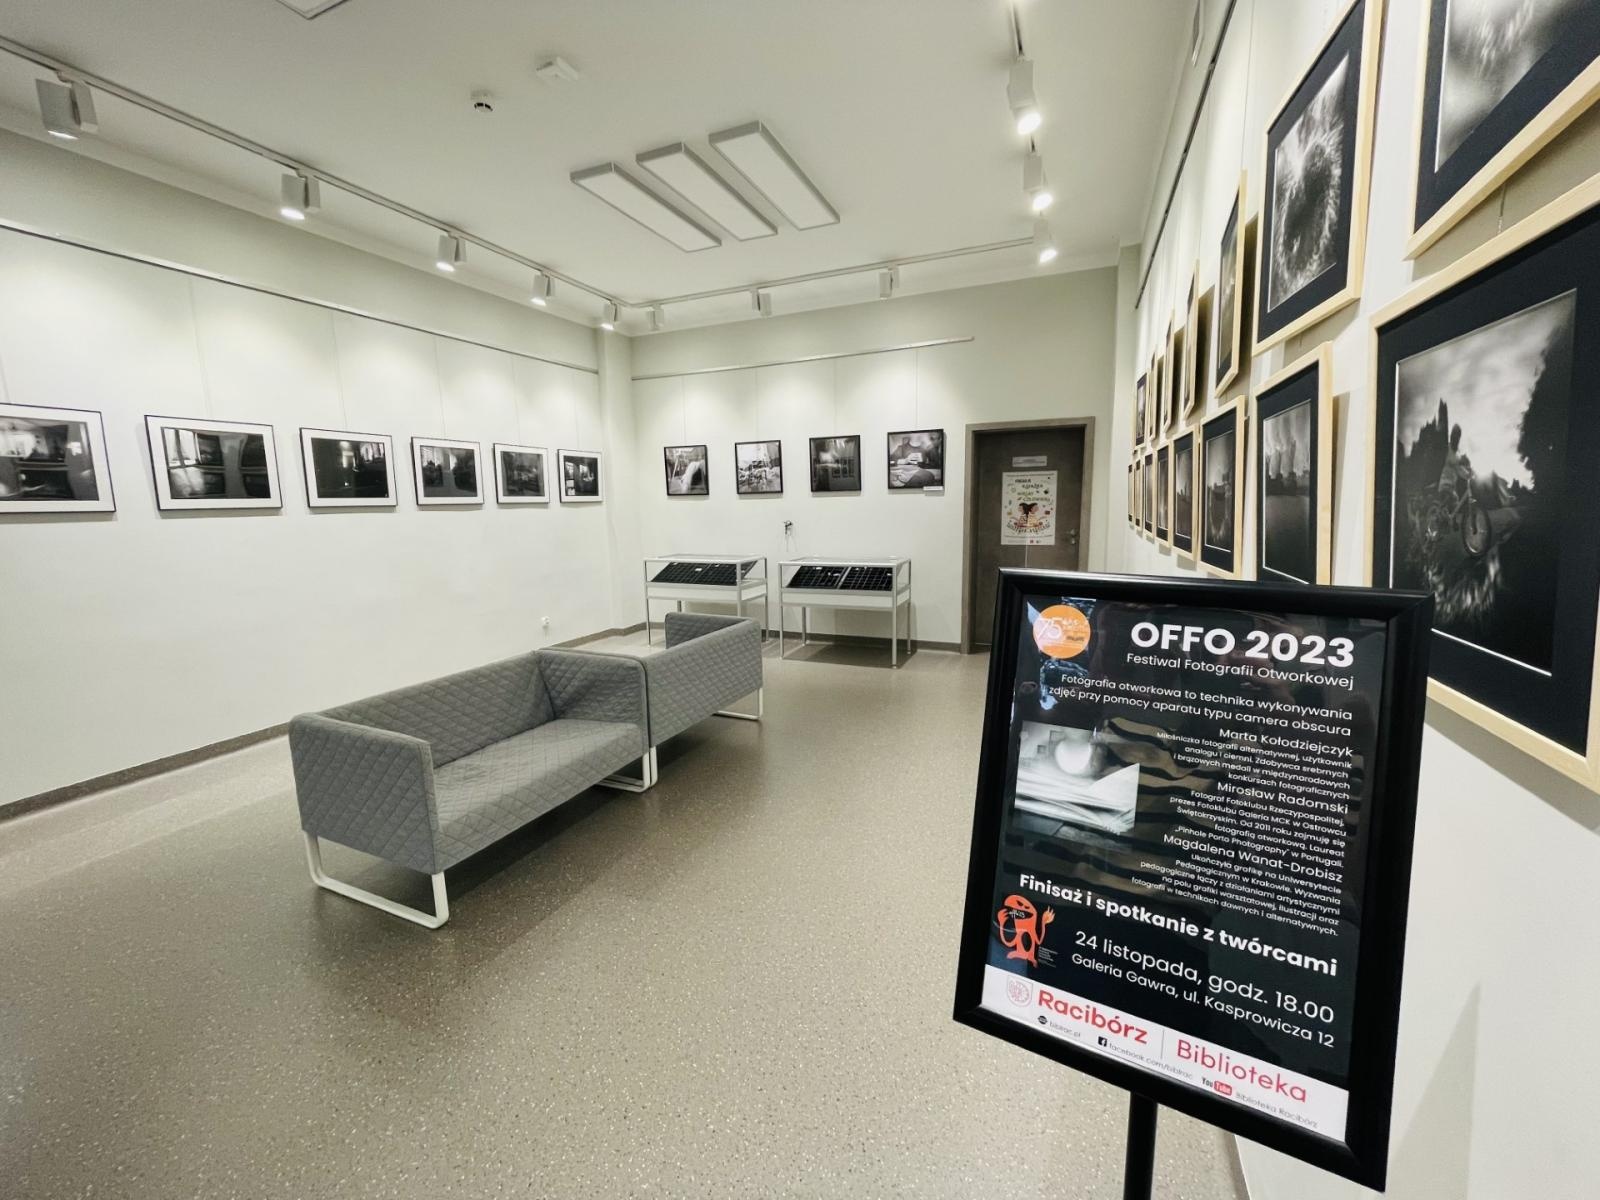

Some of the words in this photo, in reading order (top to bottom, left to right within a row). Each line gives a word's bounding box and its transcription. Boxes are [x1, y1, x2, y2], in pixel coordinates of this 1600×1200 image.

[1131, 622, 1235, 656] OFFO
[1245, 630, 1354, 668] 2023
[1127, 653, 1180, 669] Festiwal
[1185, 659, 1253, 676] Fotografii
[1258, 668, 1354, 690] Otworkowej
[1049, 687, 1076, 699] zdjęć
[1078, 690, 1101, 703] przy
[1103, 695, 1149, 709] pomocy
[1152, 700, 1201, 716] aparatu
[1204, 707, 1232, 721] typu
[1235, 713, 1289, 728] camera
[1292, 720, 1351, 736] obscura
[1061, 674, 1116, 690] Fotografia
[1119, 681, 1182, 698] otworkowa
[1185, 689, 1197, 700] to
[1200, 692, 1254, 707] technika
[1258, 702, 1353, 720] wykonywania
[1156, 732, 1200, 744] Miłośniczka
[1202, 739, 1238, 751] fotografii
[1239, 745, 1300, 762] alternatywnej,
[1302, 756, 1352, 769] użytkownik
[1184, 746, 1218, 758] analogu
[1302, 766, 1349, 779] srebrnych
[1219, 728, 1258, 743] Marta
[1261, 734, 1354, 758] Kołodziejczyk
[1177, 754, 1221, 768] brązowych
[1222, 762, 1252, 773] medali
[1261, 769, 1351, 790] międzynarodowych
[1228, 771, 1277, 786] konkursach
[1278, 781, 1350, 800] fotograficznych
[1169, 796, 1196, 807] prezes
[1196, 801, 1237, 815] Fotoklubu
[1238, 809, 1270, 821] Galeria
[1271, 815, 1291, 825] MCK
[1302, 822, 1347, 837] Ostrowcu
[1190, 790, 1225, 802] Fotograf
[1226, 797, 1268, 811] Fotoklubu
[1269, 805, 1345, 827] Rzeczypospolitej,
[1217, 782, 1276, 801] Mirosław
[1278, 792, 1349, 814] Radomski
[1208, 832, 1230, 843] Porto
[1214, 824, 1256, 839] fotografią
[1257, 834, 1308, 850] otworkową.
[1309, 844, 1345, 858] Laureat
[1240, 820, 1253, 828] Od
[1254, 822, 1271, 831] 2011
[1272, 826, 1292, 836] roku
[1293, 831, 1330, 845] zajmuję
[1332, 839, 1346, 848] się
[1163, 834, 1235, 858] Magdalena
[1238, 850, 1343, 883] Wanat-Drobisz
[1190, 854, 1232, 869] Ukończyła
[1233, 864, 1263, 876] grafikę
[1264, 871, 1277, 879] na
[1278, 873, 1342, 895] Uniwersytecie
[1140, 861, 1196, 880] pedagogiczne
[1197, 874, 1218, 886] łączy
[1225, 881, 1275, 899] działaniami
[1276, 894, 1340, 915] artystycznymi
[1161, 875, 1173, 883] na
[1173, 879, 1192, 889] polu
[1193, 883, 1219, 895] grafiki
[1278, 904, 1317, 921] ilustracji
[1318, 915, 1340, 926] oraz
[1175, 859, 1240, 880] Pedagogicznym
[1251, 878, 1293, 893] Krakowie.
[1294, 887, 1341, 905] Wyzwania
[1019, 873, 1083, 904] Finisaż
[1086, 891, 1092, 907] i
[1095, 898, 1200, 937] spotkanie
[1202, 927, 1215, 942] z
[1218, 930, 1338, 977] twórcami
[1131, 876, 1166, 890] fotografii
[1174, 888, 1219, 905] technikach
[1220, 900, 1260, 916] dawnych
[1265, 912, 1339, 937] alternatywnych.
[1075, 930, 1098, 950] 24
[1102, 938, 1203, 985] listopada,
[1208, 974, 1268, 1004] godz.
[1275, 990, 1334, 1024] 18.00
[1071, 953, 1123, 979] Galeria
[1125, 970, 1179, 998] Gawra,
[1183, 990, 1201, 1005] ul.
[1204, 995, 1313, 1041] Kasprowicza
[1317, 1031, 1335, 1048] 12
[1038, 989, 1149, 1045] Racibórz
[1176, 1038, 1307, 1103] Biblioteka
[1278, 1107, 1319, 1129] Racibórz
